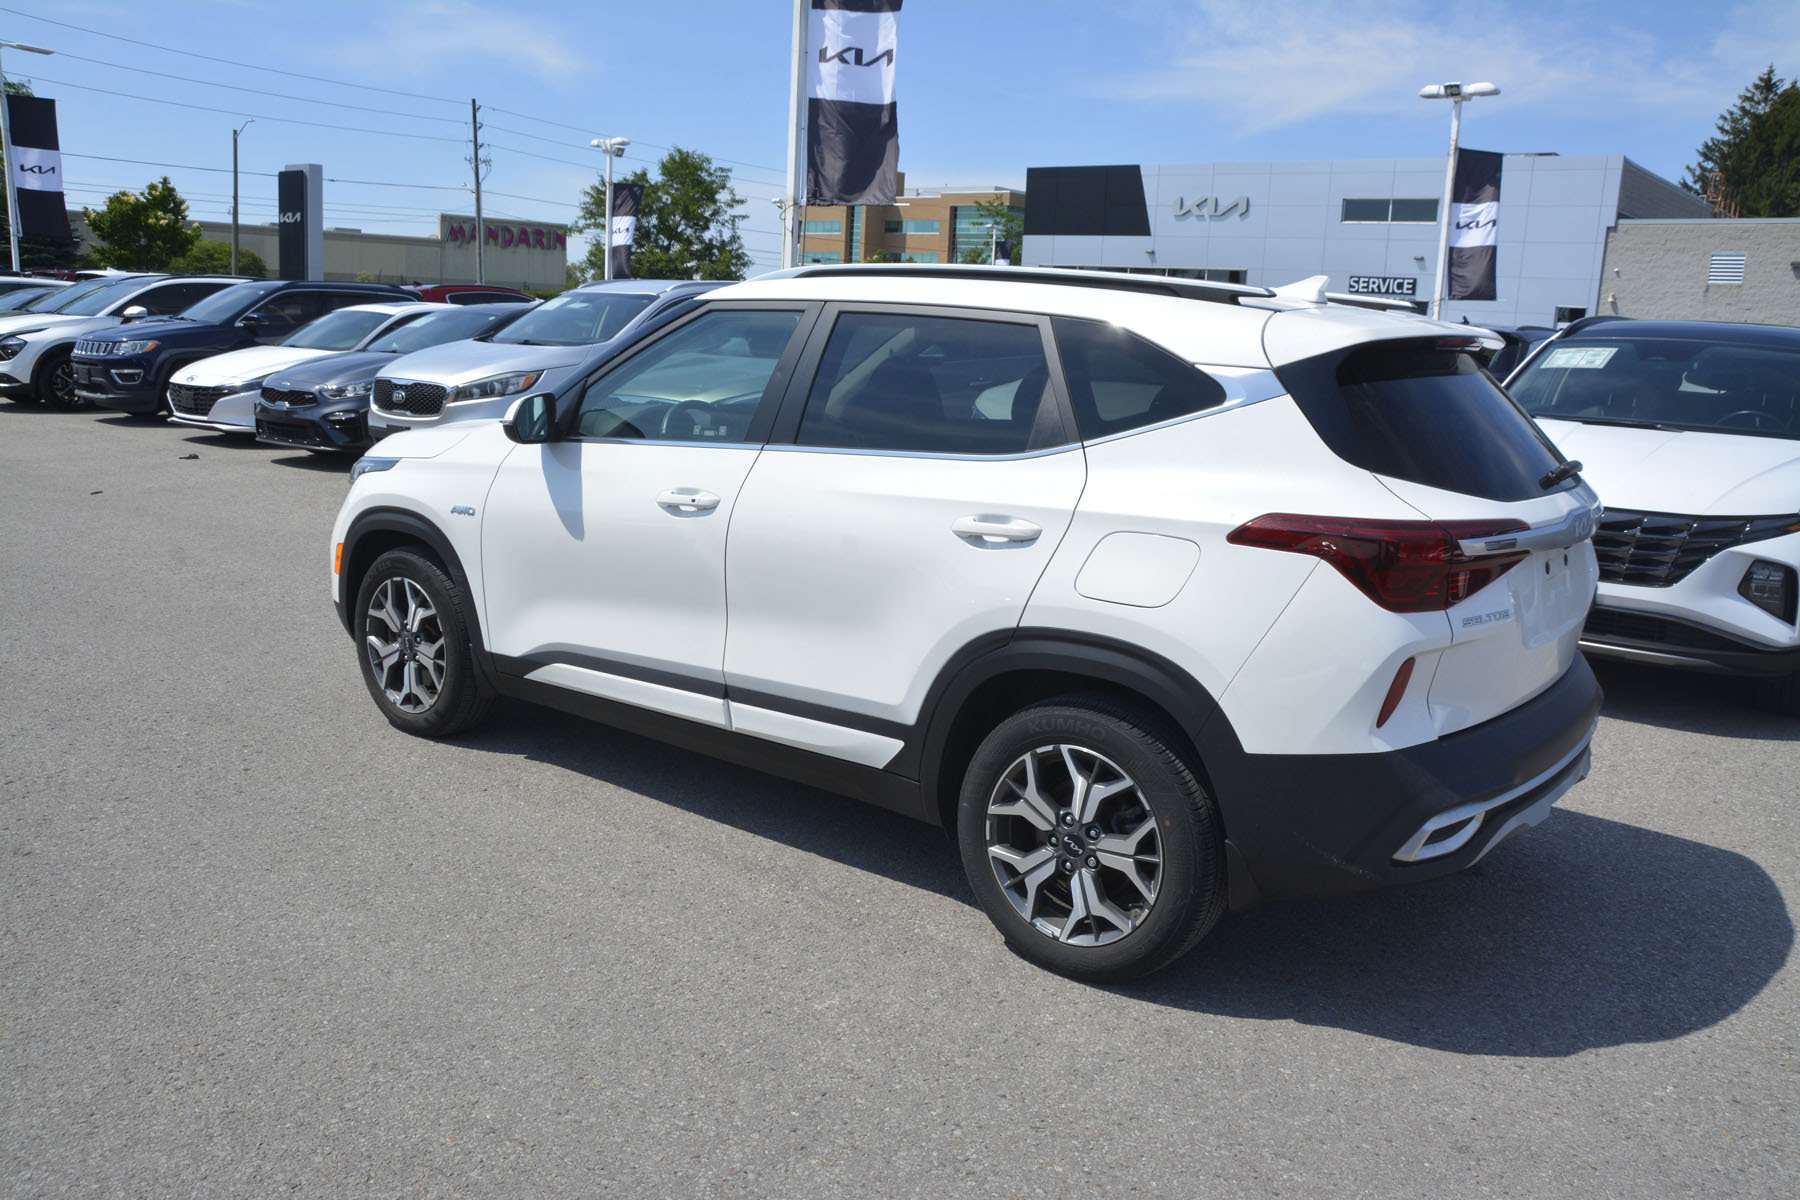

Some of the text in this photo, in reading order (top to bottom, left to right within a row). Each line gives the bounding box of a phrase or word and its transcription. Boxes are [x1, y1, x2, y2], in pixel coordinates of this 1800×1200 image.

[818, 46, 894, 67] KIA
[20, 164, 56, 175] KIA
[279, 211, 302, 223] KIA
[1173, 196, 1249, 218] KIA
[1455, 218, 1497, 230] KIA
[447, 222, 567, 250] MANDARIN
[1348, 276, 1415, 295] SERVICE
[1028, 718, 1106, 740] KUMHO
